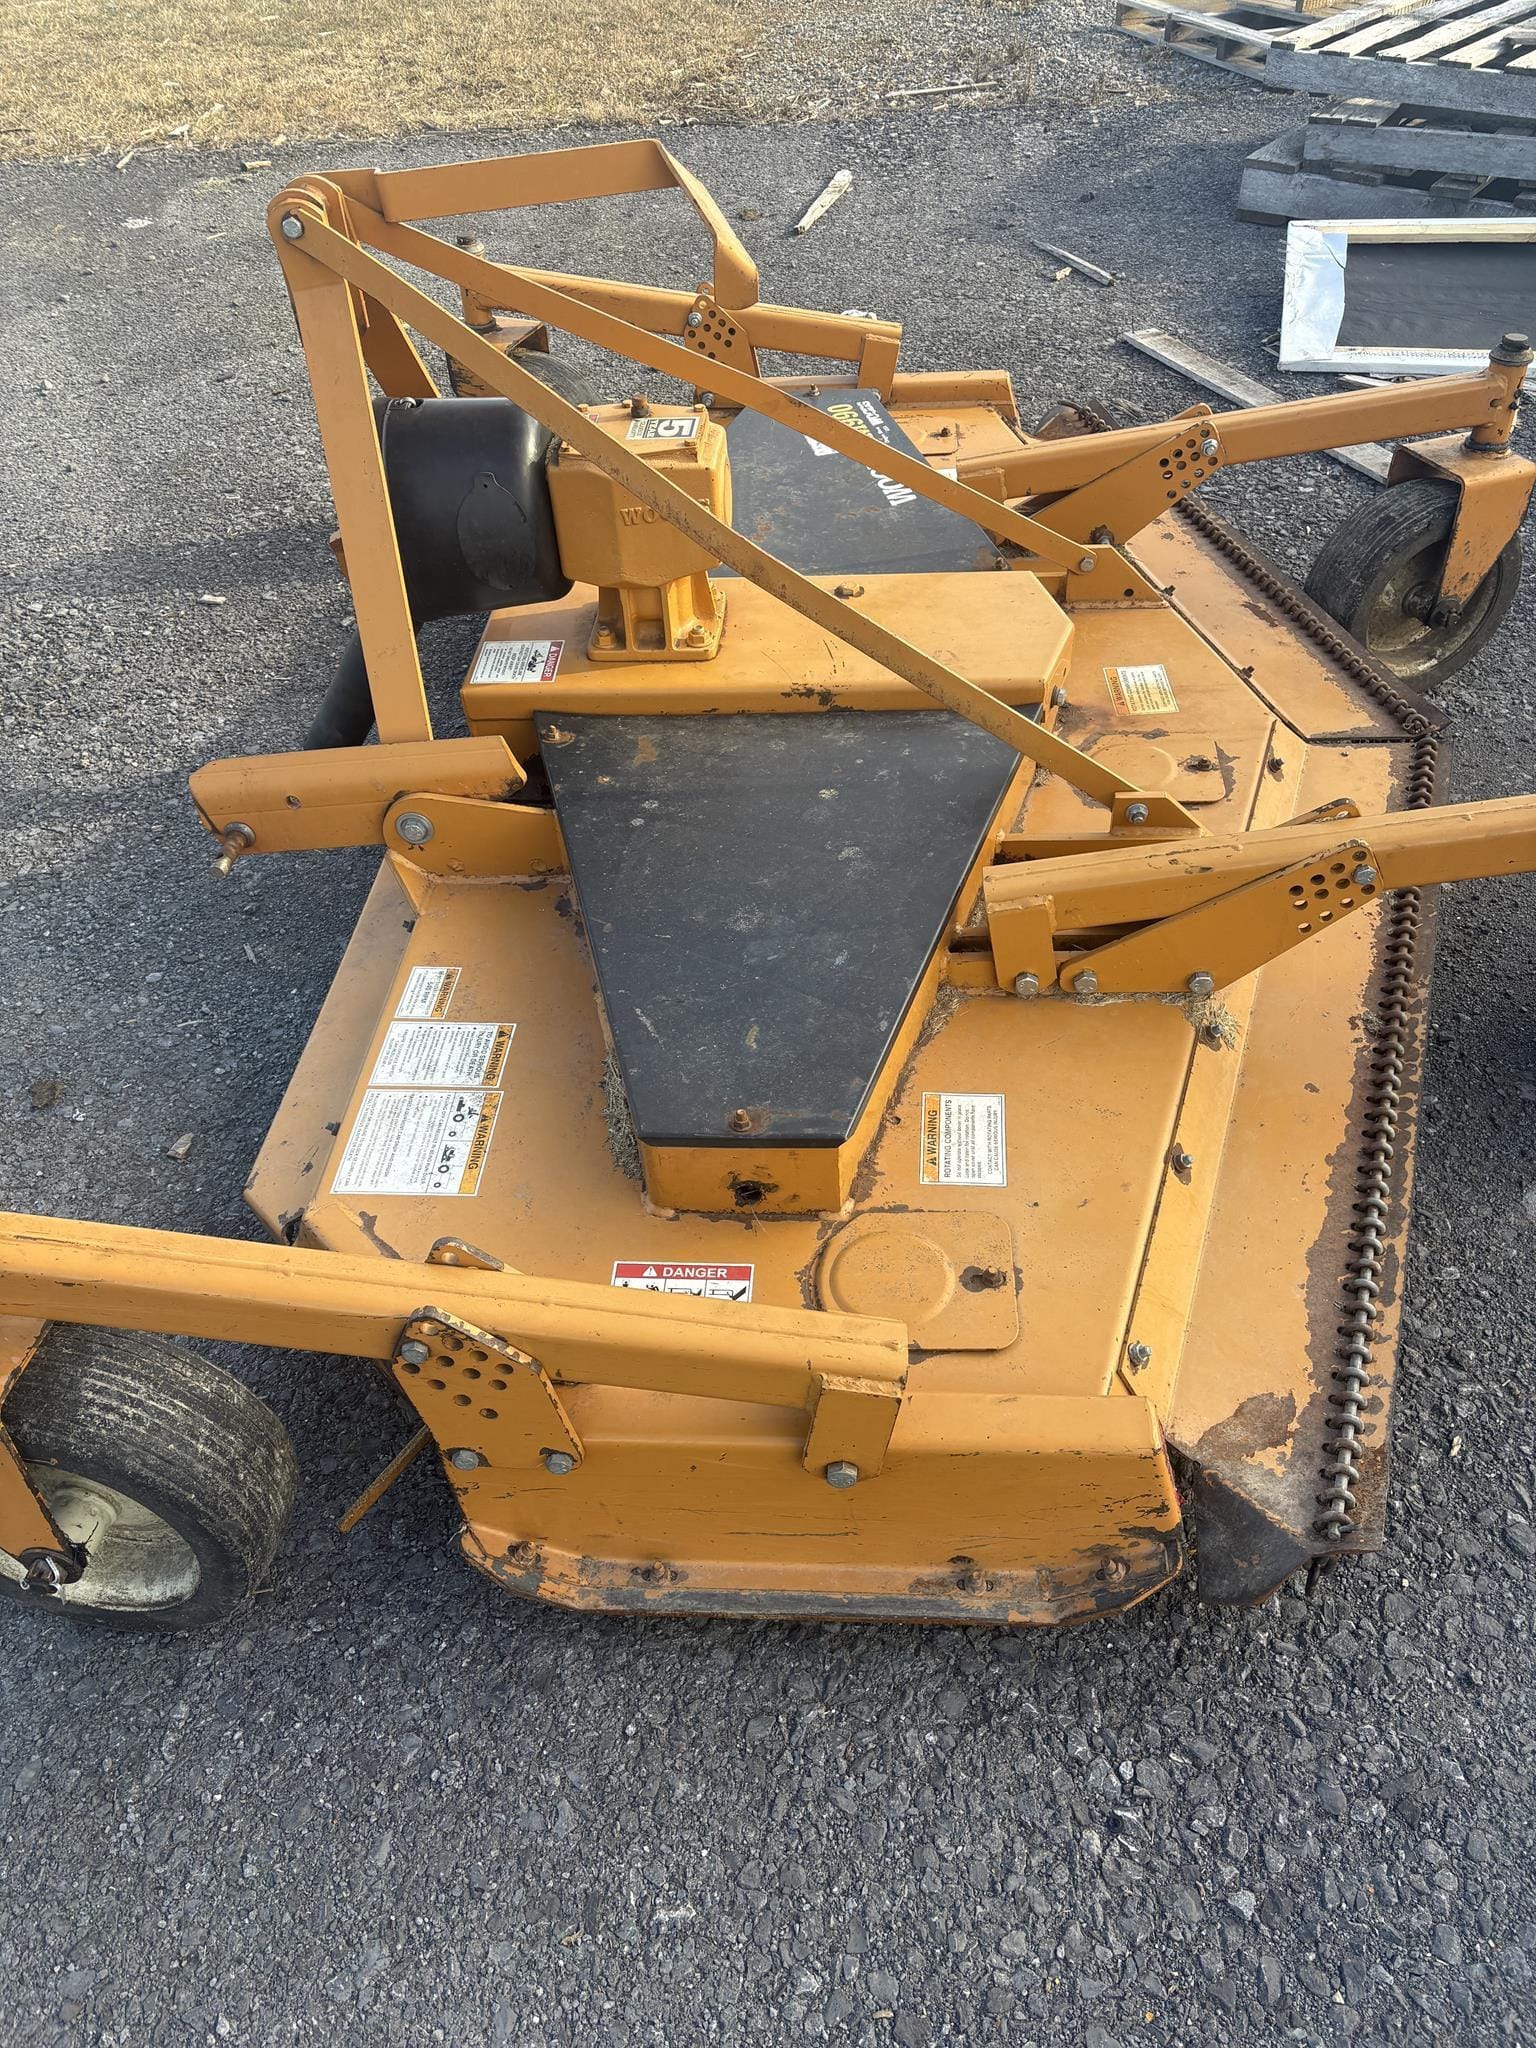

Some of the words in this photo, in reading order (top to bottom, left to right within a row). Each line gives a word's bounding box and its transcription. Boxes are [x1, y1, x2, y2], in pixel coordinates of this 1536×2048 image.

[646, 419, 659, 438] YEAR
[657, 419, 693, 437] 5
[543, 653, 557, 676] DANGER
[434, 981, 452, 1012] WARNING
[485, 1040, 505, 1079] WARNING
[467, 1125, 488, 1169] WARNING
[926, 1109, 937, 1154] WARNING
[943, 1145, 951, 1177] ROTATING
[662, 1267, 728, 1278] DANGER
